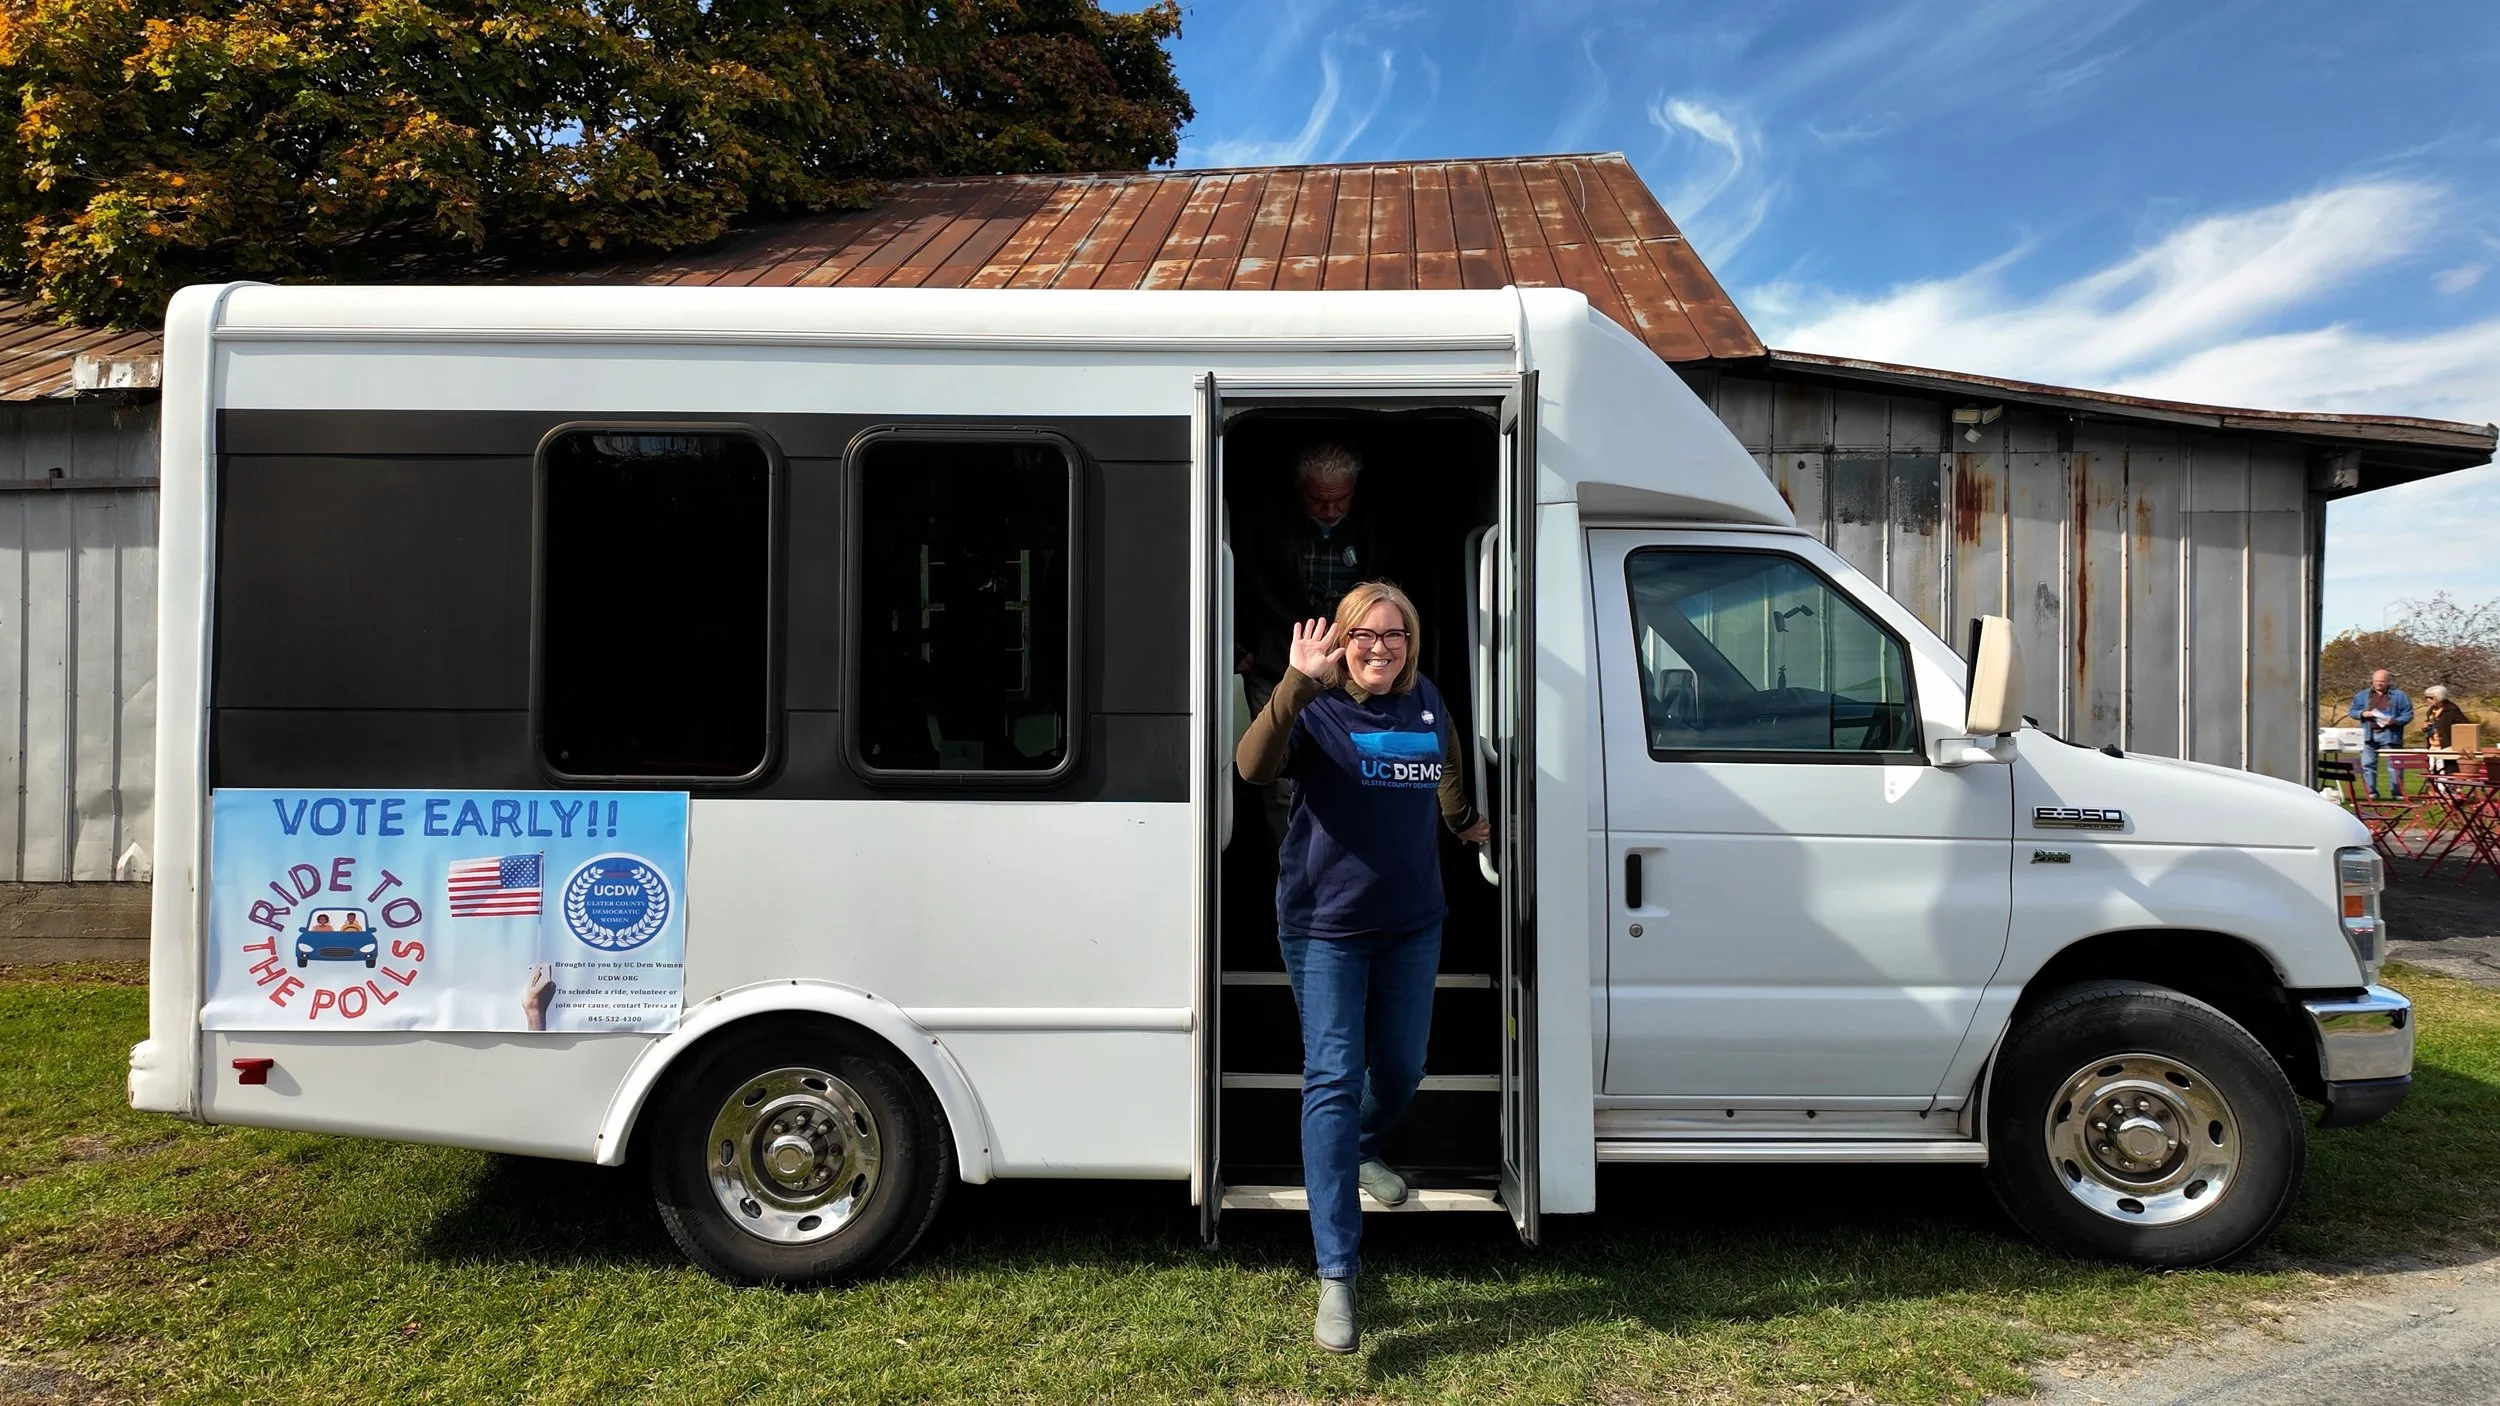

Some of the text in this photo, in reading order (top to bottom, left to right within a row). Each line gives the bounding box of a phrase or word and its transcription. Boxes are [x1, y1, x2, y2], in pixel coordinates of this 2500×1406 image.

[1361, 760, 1442, 781] UC DEMS
[1387, 780, 1412, 788] COUNTY
[273, 797, 619, 838] VOTE EARLY!!
[248, 857, 423, 932] RIDE TO
[594, 885, 640, 896] UCDW
[242, 936, 426, 1020] THE POLLS
